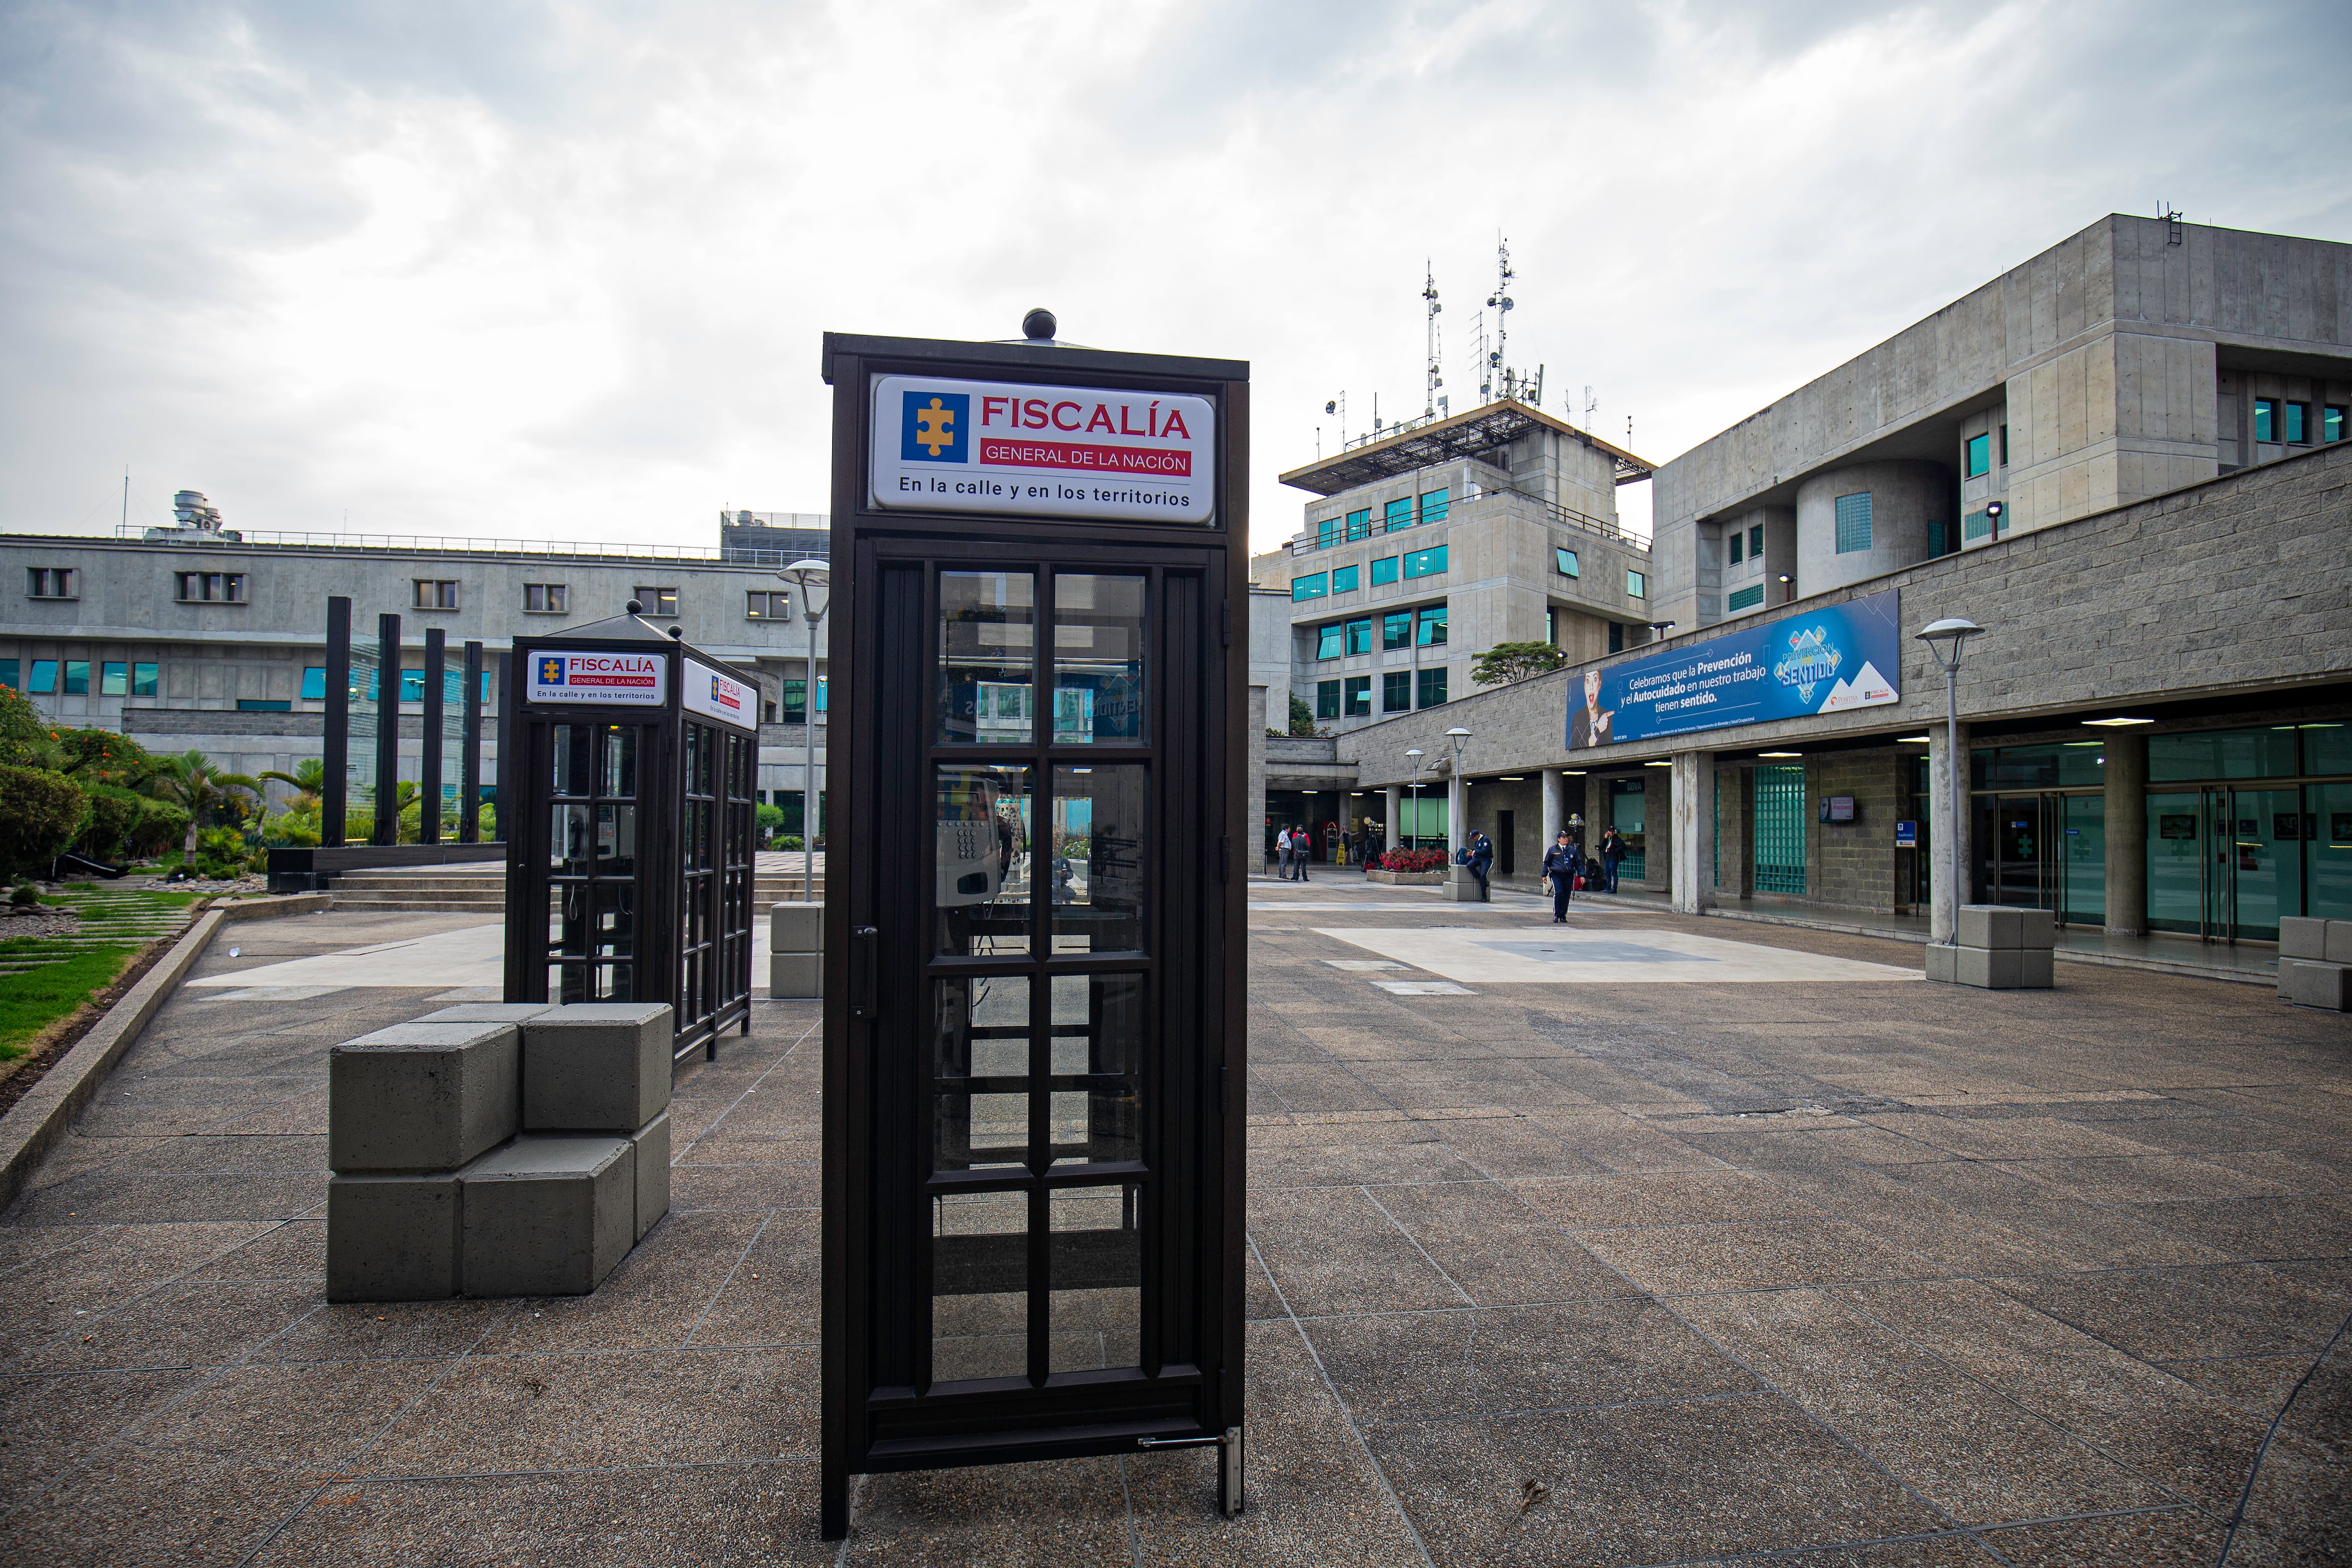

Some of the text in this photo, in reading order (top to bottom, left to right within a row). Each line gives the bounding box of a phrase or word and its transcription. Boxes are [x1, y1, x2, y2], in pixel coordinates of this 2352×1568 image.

[981, 396, 1191, 439] FISCALÍA
[985, 445, 1186, 470] GENERAL DE LA NACIÓN
[900, 477, 1190, 507] En la calle y en los territorios
[1783, 642, 1833, 661] PREVENCIÓN
[570, 657, 655, 672] FISCALÍA
[1630, 652, 1751, 690] Celebramos que la Prevención
[720, 679, 740, 697] FISCALÍA
[1621, 665, 1766, 708] y el Autocuidado en nuestro trabajo
[1655, 691, 1717, 712] tienen sentido.
[1627, 782, 1642, 791] BBVA
